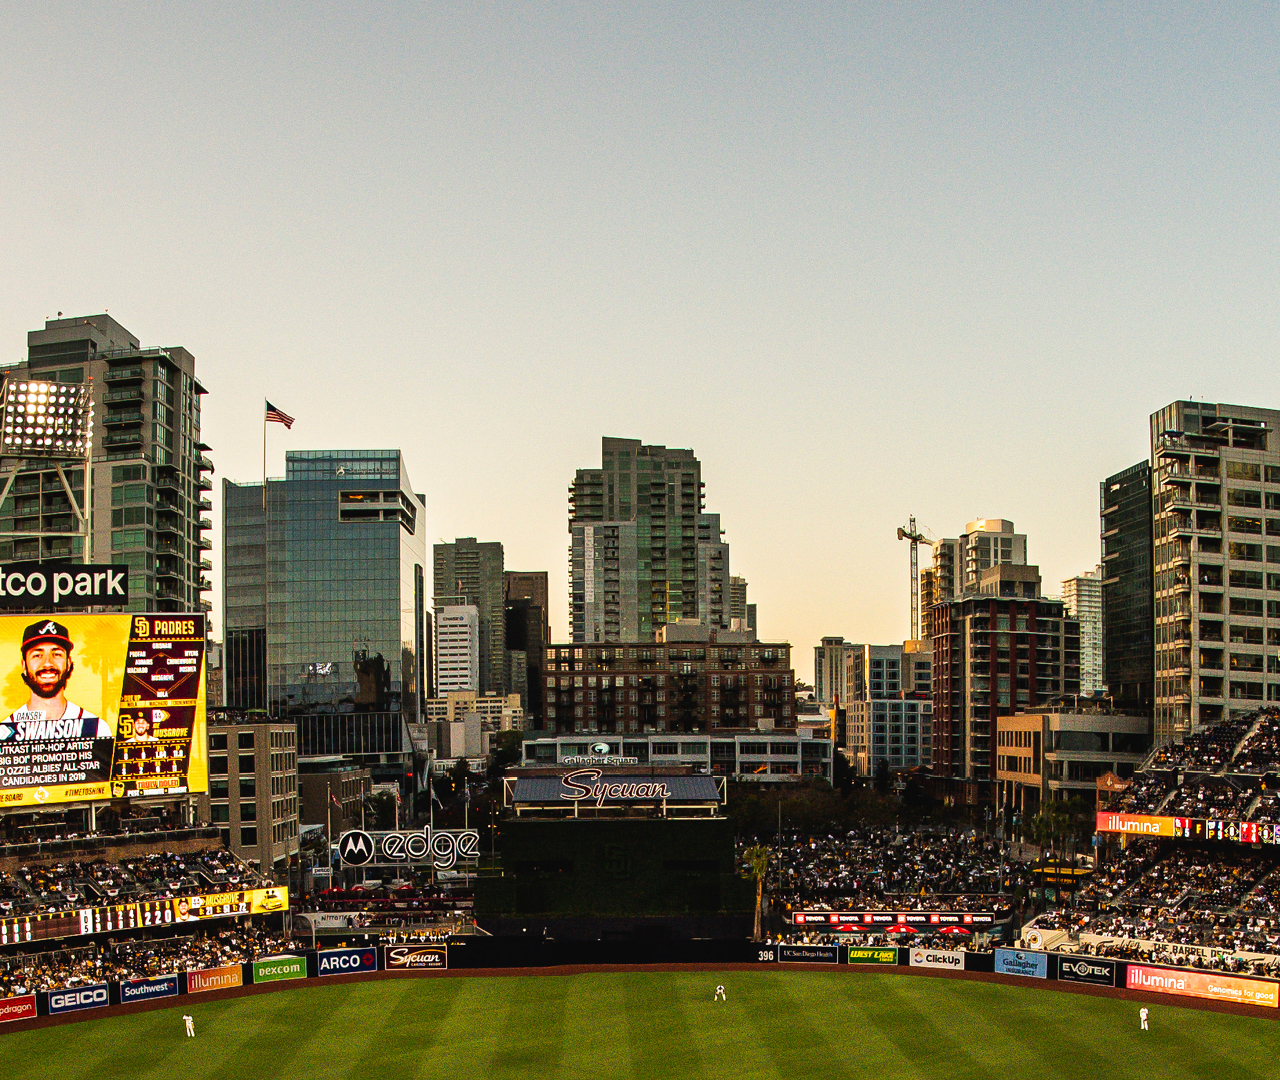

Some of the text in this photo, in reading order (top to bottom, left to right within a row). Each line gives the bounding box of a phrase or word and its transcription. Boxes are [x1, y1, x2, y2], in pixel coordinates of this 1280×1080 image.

[53, 569, 125, 602] park
[154, 620, 195, 634] PADRES
[16, 711, 42, 721] DANSBY
[15, 718, 84, 741] SWANSON
[153, 728, 188, 738] MUSGROVE
[32, 742, 66, 753] HIP-HOP
[66, 740, 94, 751] ARTIST
[32, 752, 78, 763] PROMOTED
[78, 752, 92, 760] HIS
[562, 756, 638, 766] Gallagher Square
[6, 766, 30, 776] OZZIE
[32, 762, 62, 774] ALBIES'
[62, 760, 100, 772] ALL-STAR
[2, 772, 86, 786] CANDIDACIES IN 2019
[64, 786, 105, 797] #TIMETOSHINE
[560, 768, 672, 807] Sycuan
[4, 793, 23, 802] BOARD
[1108, 816, 1158, 832] illumina
[381, 825, 480, 869] edge
[206, 892, 240, 906] MUSGROVE
[238, 902, 246, 912] 72
[144, 912, 162, 926] 2 2
[390, 947, 440, 967] Sycuan
[758, 950, 774, 961] 396
[850, 950, 894, 959] WEST LAKE
[1153, 943, 1170, 952] THE
[1172, 945, 1207, 958] BARREL
[320, 954, 360, 970] ARCO
[926, 954, 960, 966] ClickUp
[1002, 958, 1038, 970] Gallagher
[190, 971, 238, 990] illumina
[1130, 970, 1185, 990] illumina
[1208, 984, 1242, 996] Genomics
[1256, 992, 1274, 1002] good
[124, 982, 168, 996] Southwest
[51, 988, 107, 1008] GEICO
